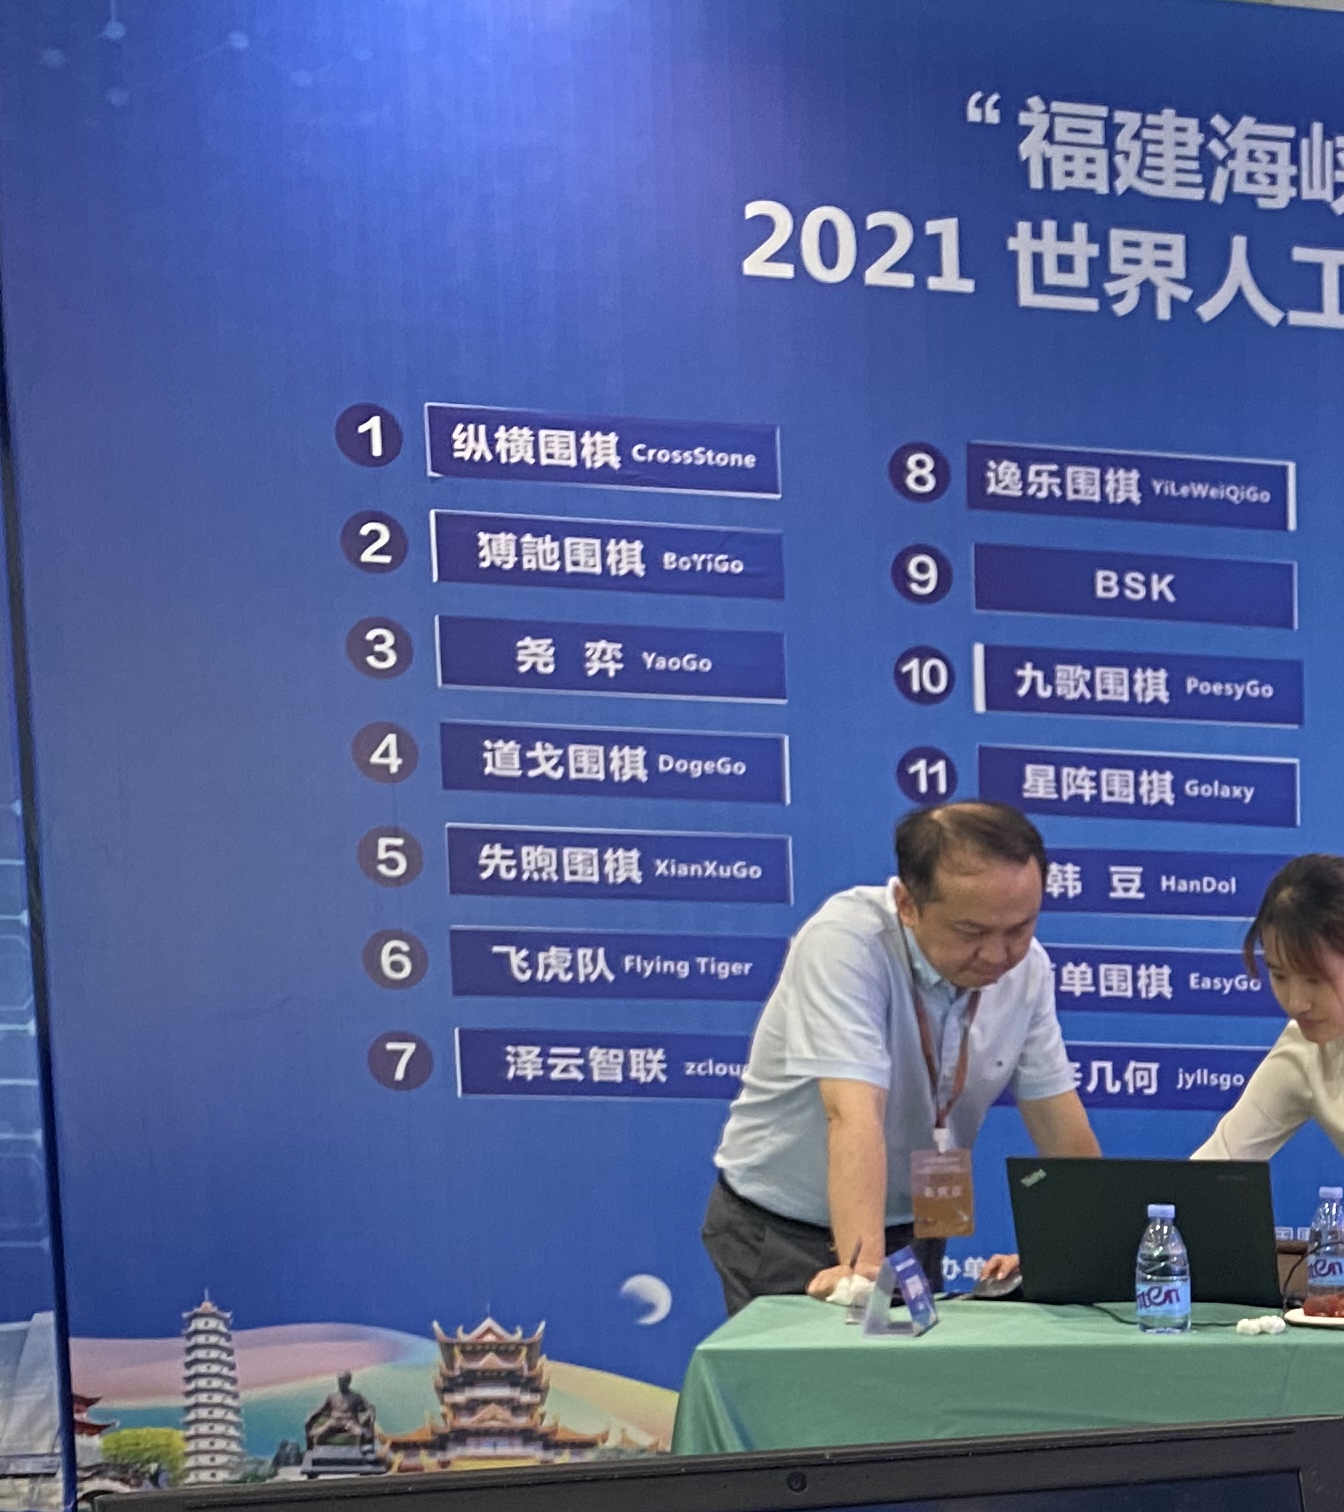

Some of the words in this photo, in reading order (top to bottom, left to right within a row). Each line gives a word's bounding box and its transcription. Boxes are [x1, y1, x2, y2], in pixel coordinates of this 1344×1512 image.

[742, 200, 974, 292] 2021
[358, 416, 382, 456] 1
[452, 423, 621, 470] 纵横围棋
[631, 444, 756, 468] CrossStone
[906, 453, 935, 492] 8
[986, 460, 1141, 505] 逸乐围棋
[1152, 479, 1271, 504] YiLeWeiQiGo
[360, 522, 392, 563] 2
[663, 552, 743, 573] BoYiGo
[908, 555, 937, 594] 9
[1096, 570, 1175, 602] BSK
[366, 628, 397, 669] 3
[642, 652, 712, 672] YaoGo
[902, 658, 947, 693] 10
[1016, 662, 1169, 704] 九歌围棋
[1186, 677, 1273, 700] PoesyGo
[370, 734, 402, 773] 4
[483, 739, 648, 782] 道戈围棋
[659, 754, 746, 778] DogeGo
[909, 759, 946, 793] 11
[1023, 764, 1175, 806] 星阵围棋
[1185, 779, 1254, 803] Golaxy
[377, 837, 407, 877] 5
[655, 859, 762, 878] XianXuGo
[1161, 875, 1236, 893] HanDol
[381, 940, 411, 979] 6
[492, 946, 615, 983] 飞虎队
[624, 955, 689, 978] Flying
[696, 957, 753, 979] Tiger
[1051, 962, 1172, 999] 单围棋
[1189, 973, 1261, 992] EasyGo
[386, 1042, 416, 1080] 7
[505, 1045, 667, 1083] 泽云智联
